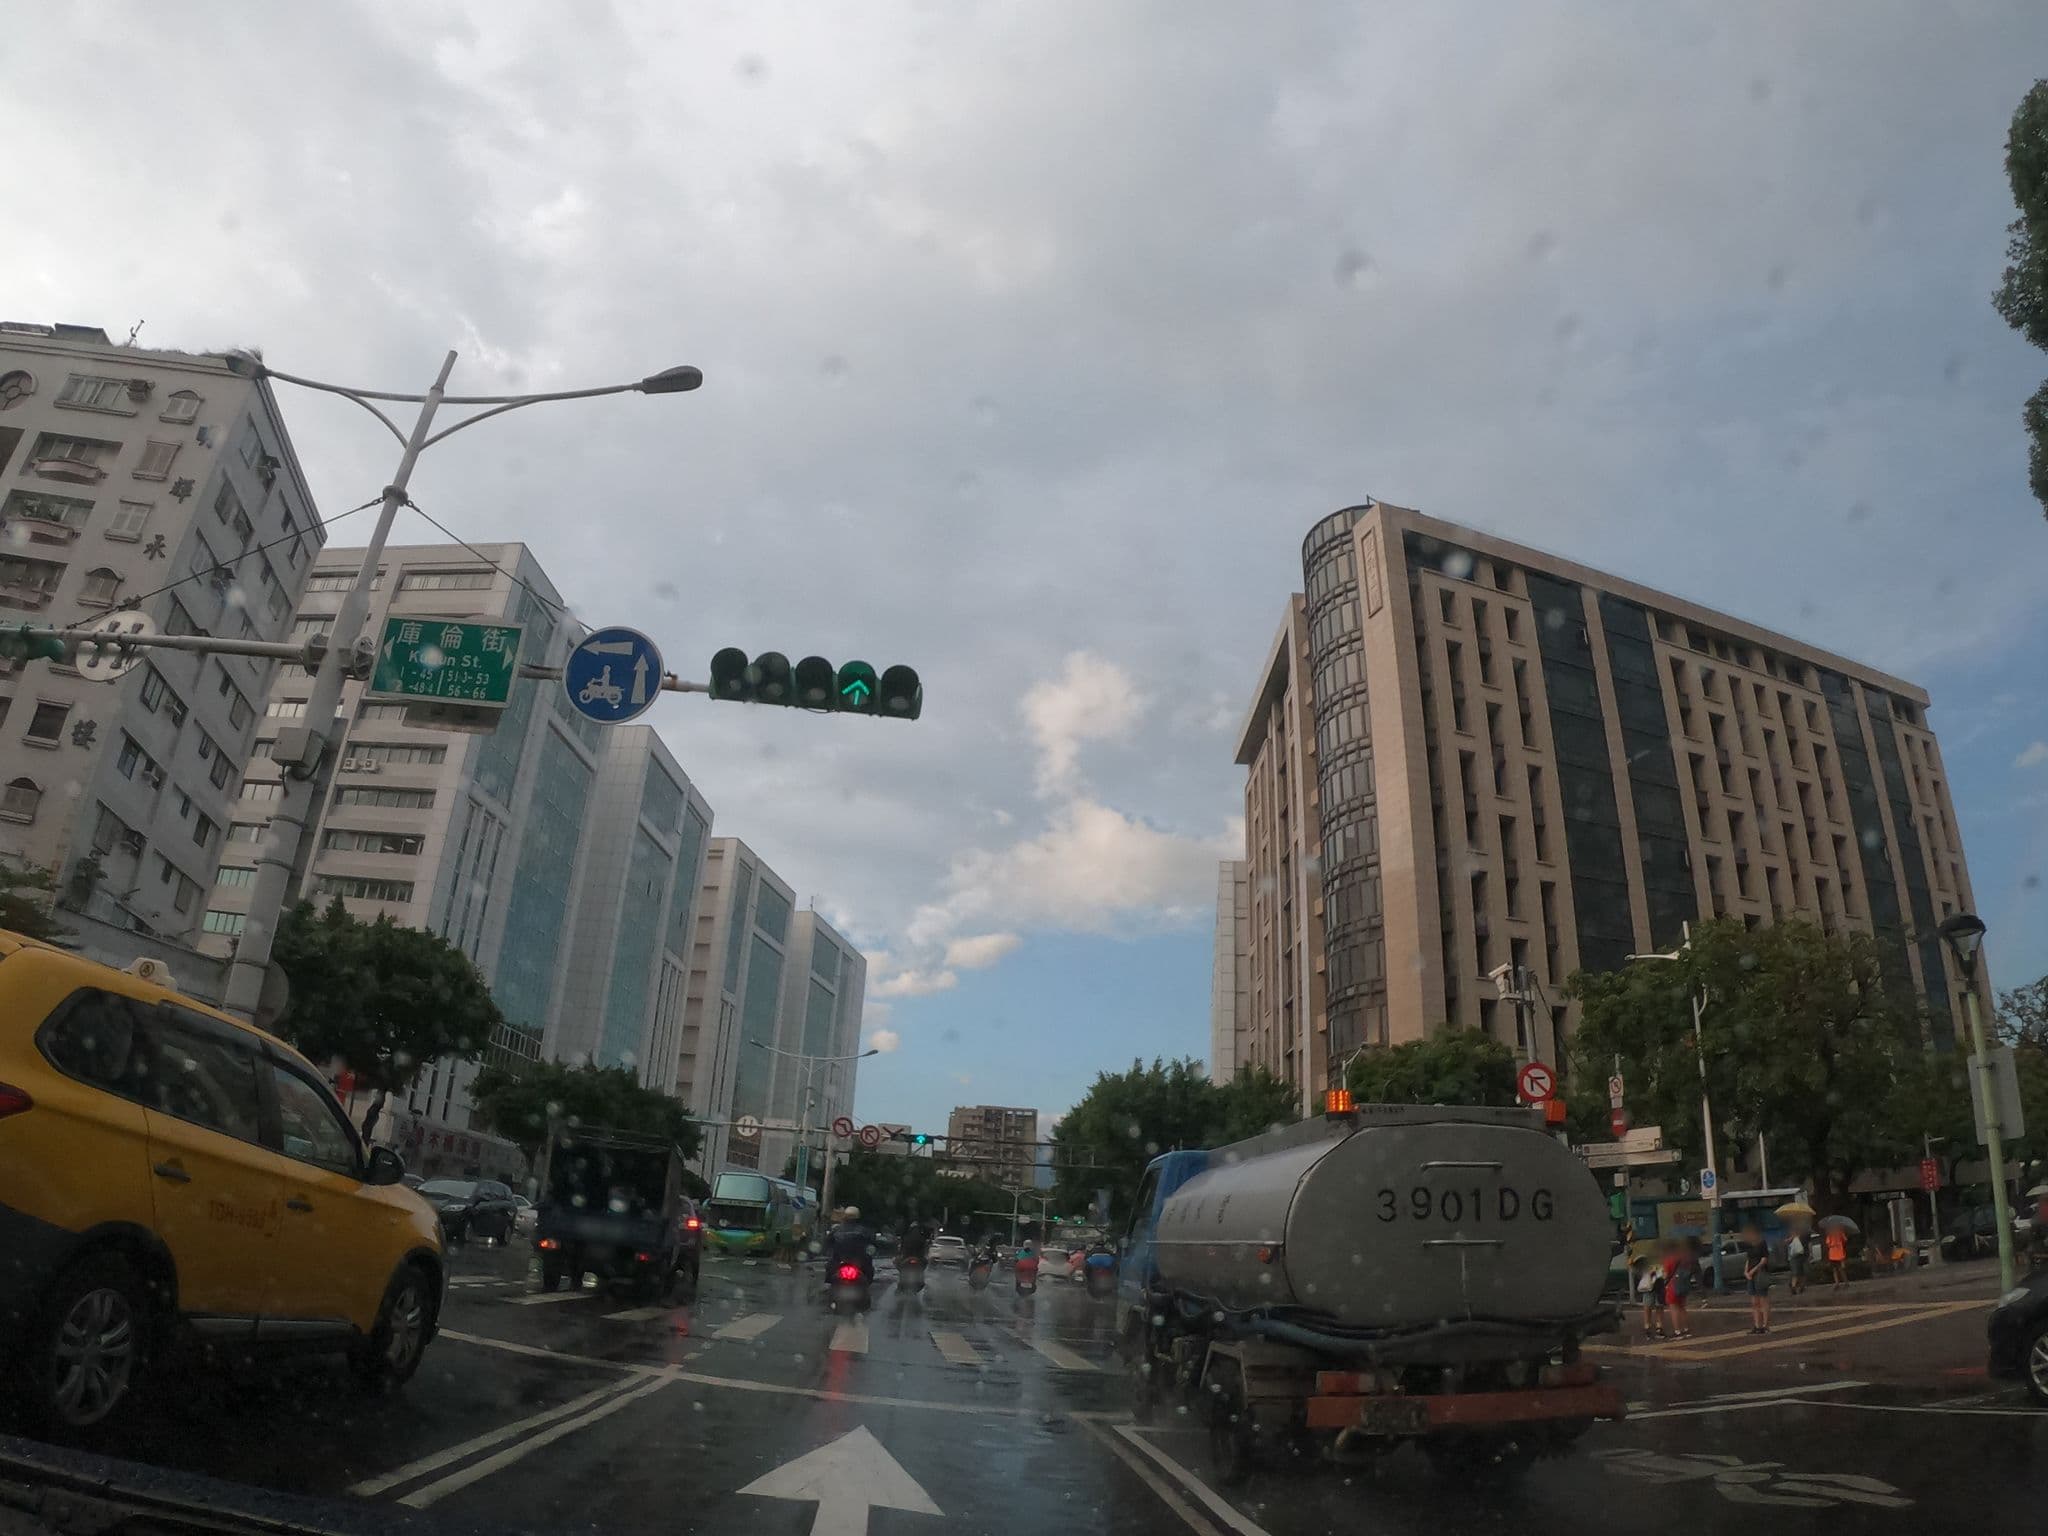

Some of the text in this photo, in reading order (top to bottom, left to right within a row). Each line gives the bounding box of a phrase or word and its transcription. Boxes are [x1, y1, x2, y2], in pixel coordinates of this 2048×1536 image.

[396, 621, 508, 653] 庫倫街
[460, 654, 482, 669] St.
[1376, 1186, 1553, 1223] 3901DG
